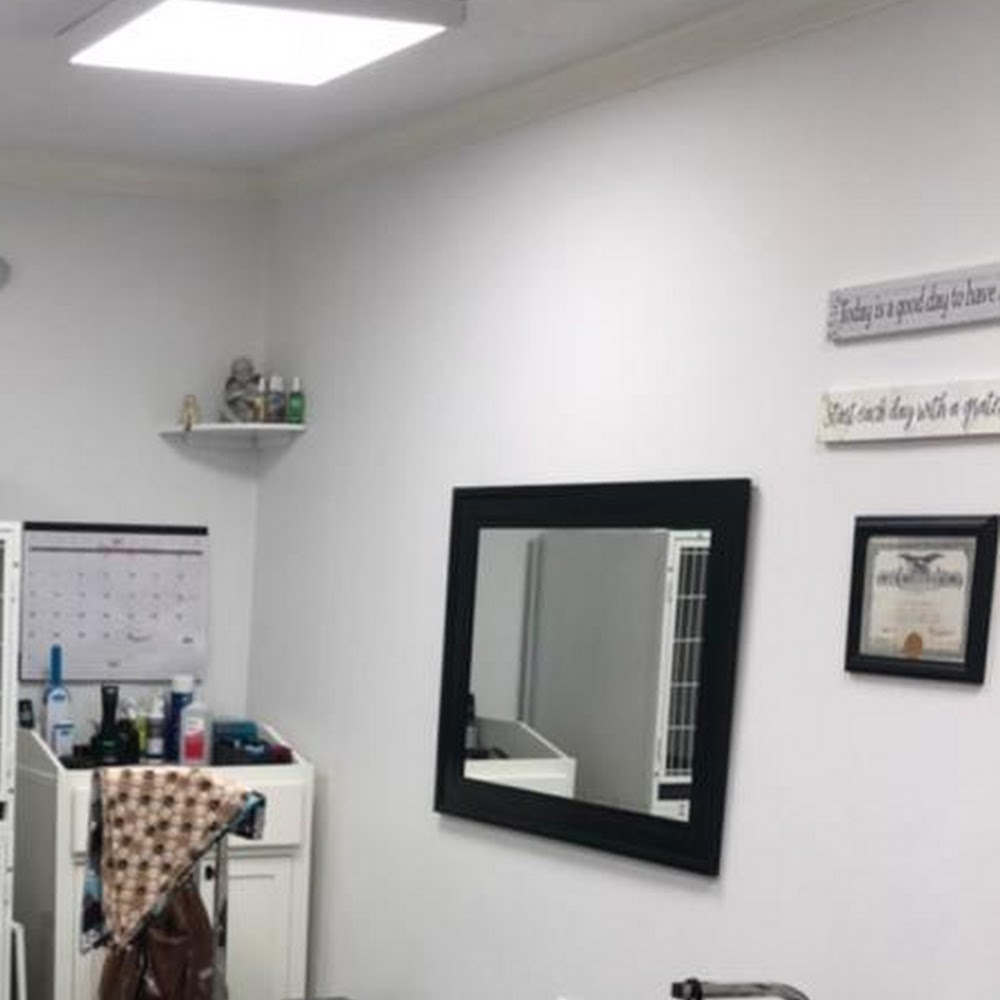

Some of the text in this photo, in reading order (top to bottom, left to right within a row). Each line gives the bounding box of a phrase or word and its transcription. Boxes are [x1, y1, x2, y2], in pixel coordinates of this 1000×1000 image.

[897, 284, 926, 324] good
[926, 282, 949, 319] day
[951, 286, 965, 309] to
[965, 277, 996, 307] have
